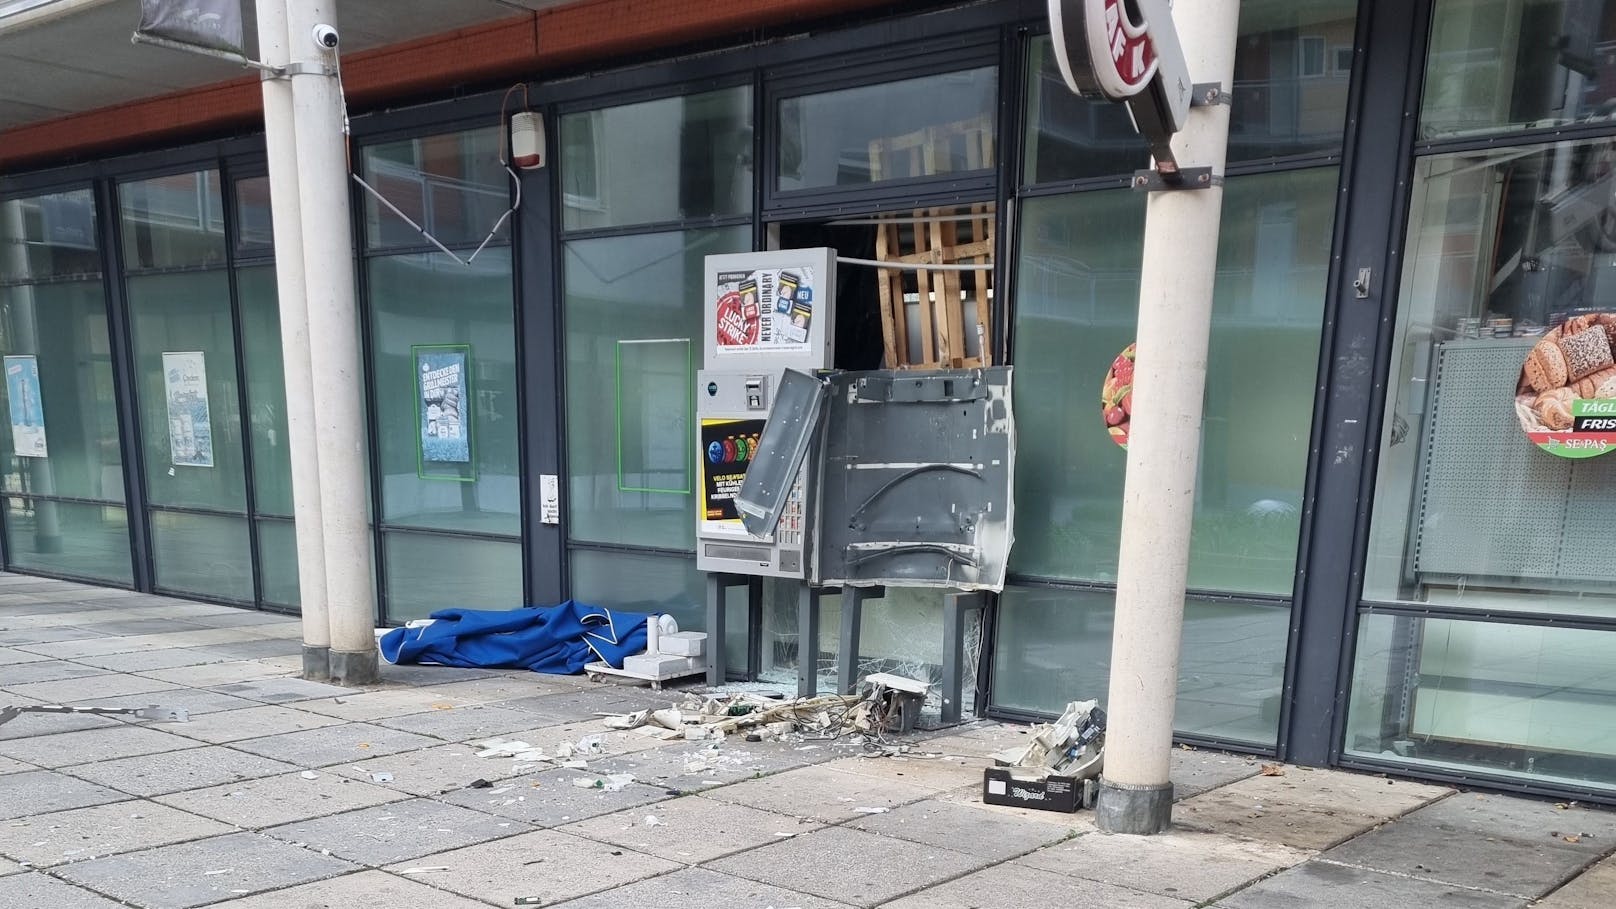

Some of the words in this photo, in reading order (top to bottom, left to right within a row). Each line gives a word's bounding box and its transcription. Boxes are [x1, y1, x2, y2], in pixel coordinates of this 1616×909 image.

[761, 273, 772, 314] ORDINARY
[796, 289, 809, 300] NEU
[718, 317, 749, 345] STRIKE
[724, 307, 751, 333] LUCKY
[761, 317, 772, 342] NEVER
